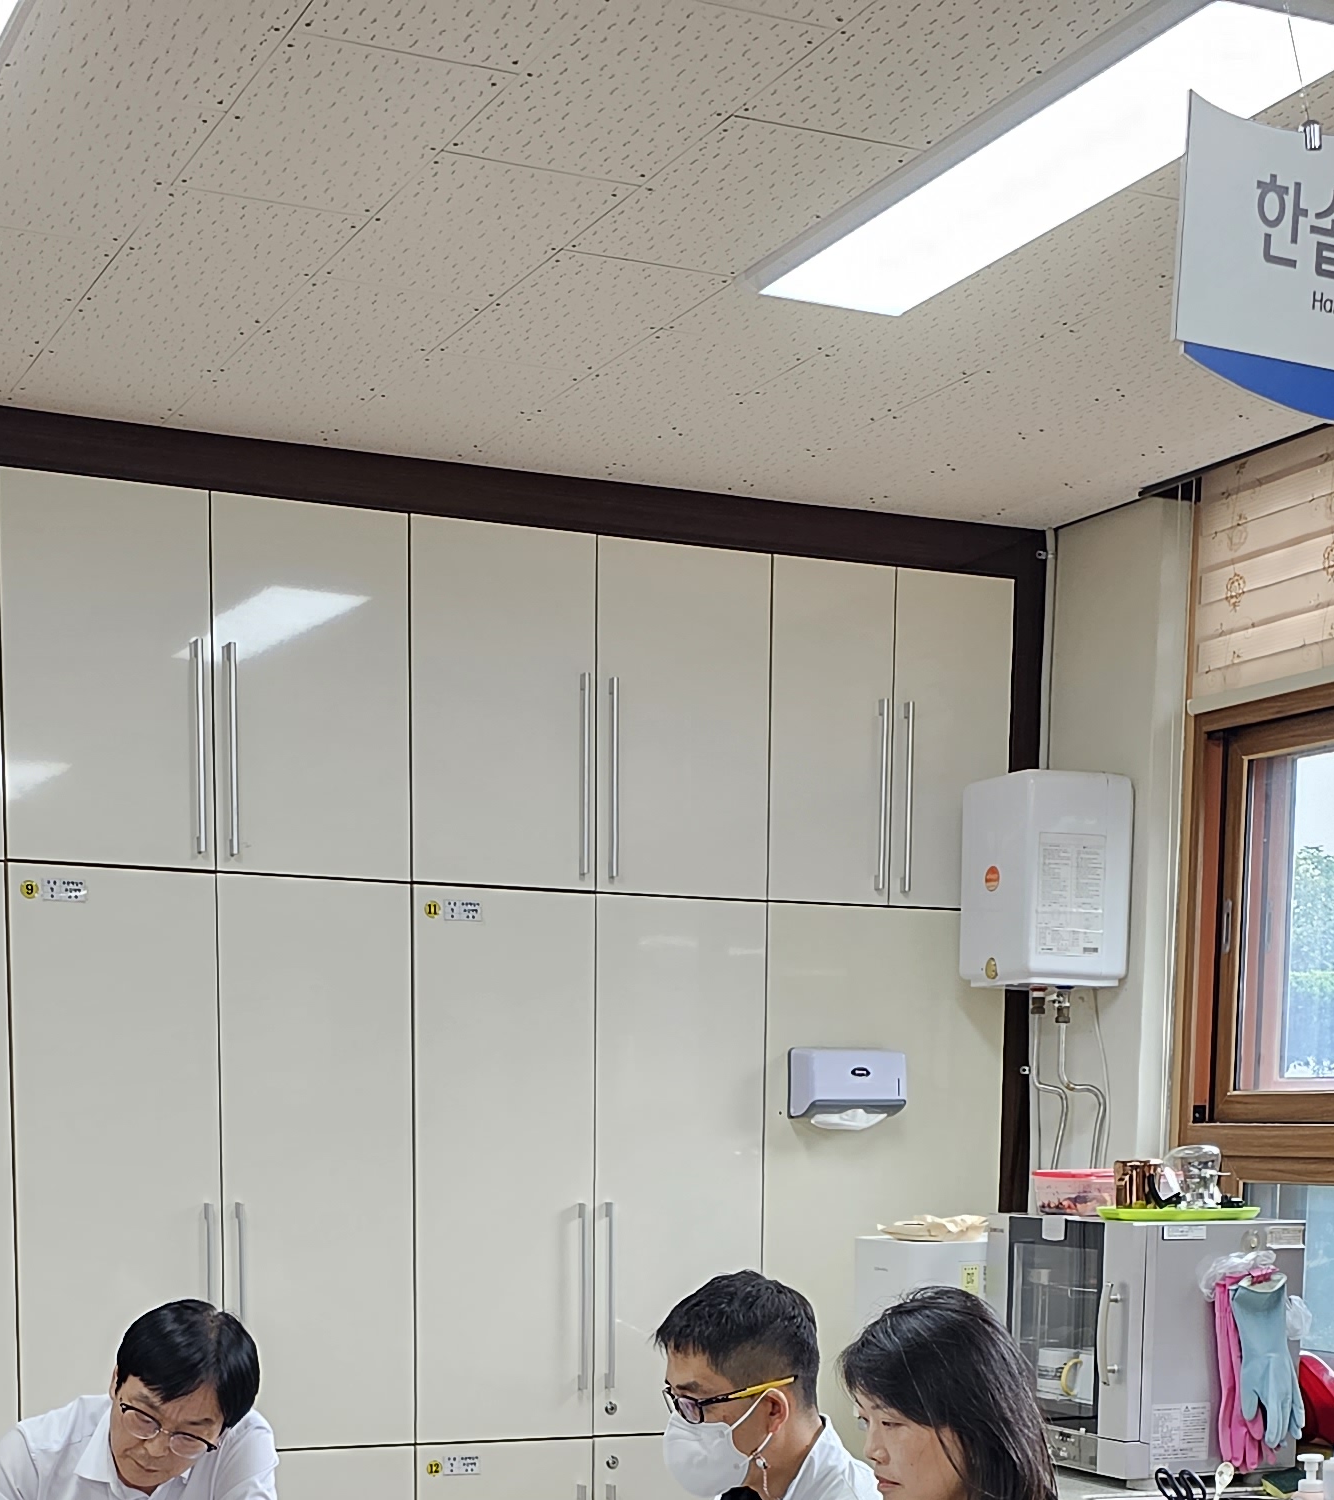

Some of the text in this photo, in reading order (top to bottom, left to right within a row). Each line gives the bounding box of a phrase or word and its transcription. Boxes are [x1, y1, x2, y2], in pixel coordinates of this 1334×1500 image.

[25, 883, 34, 895] 9
[427, 903, 440, 915] 11
[428, 1462, 440, 1474] 12
